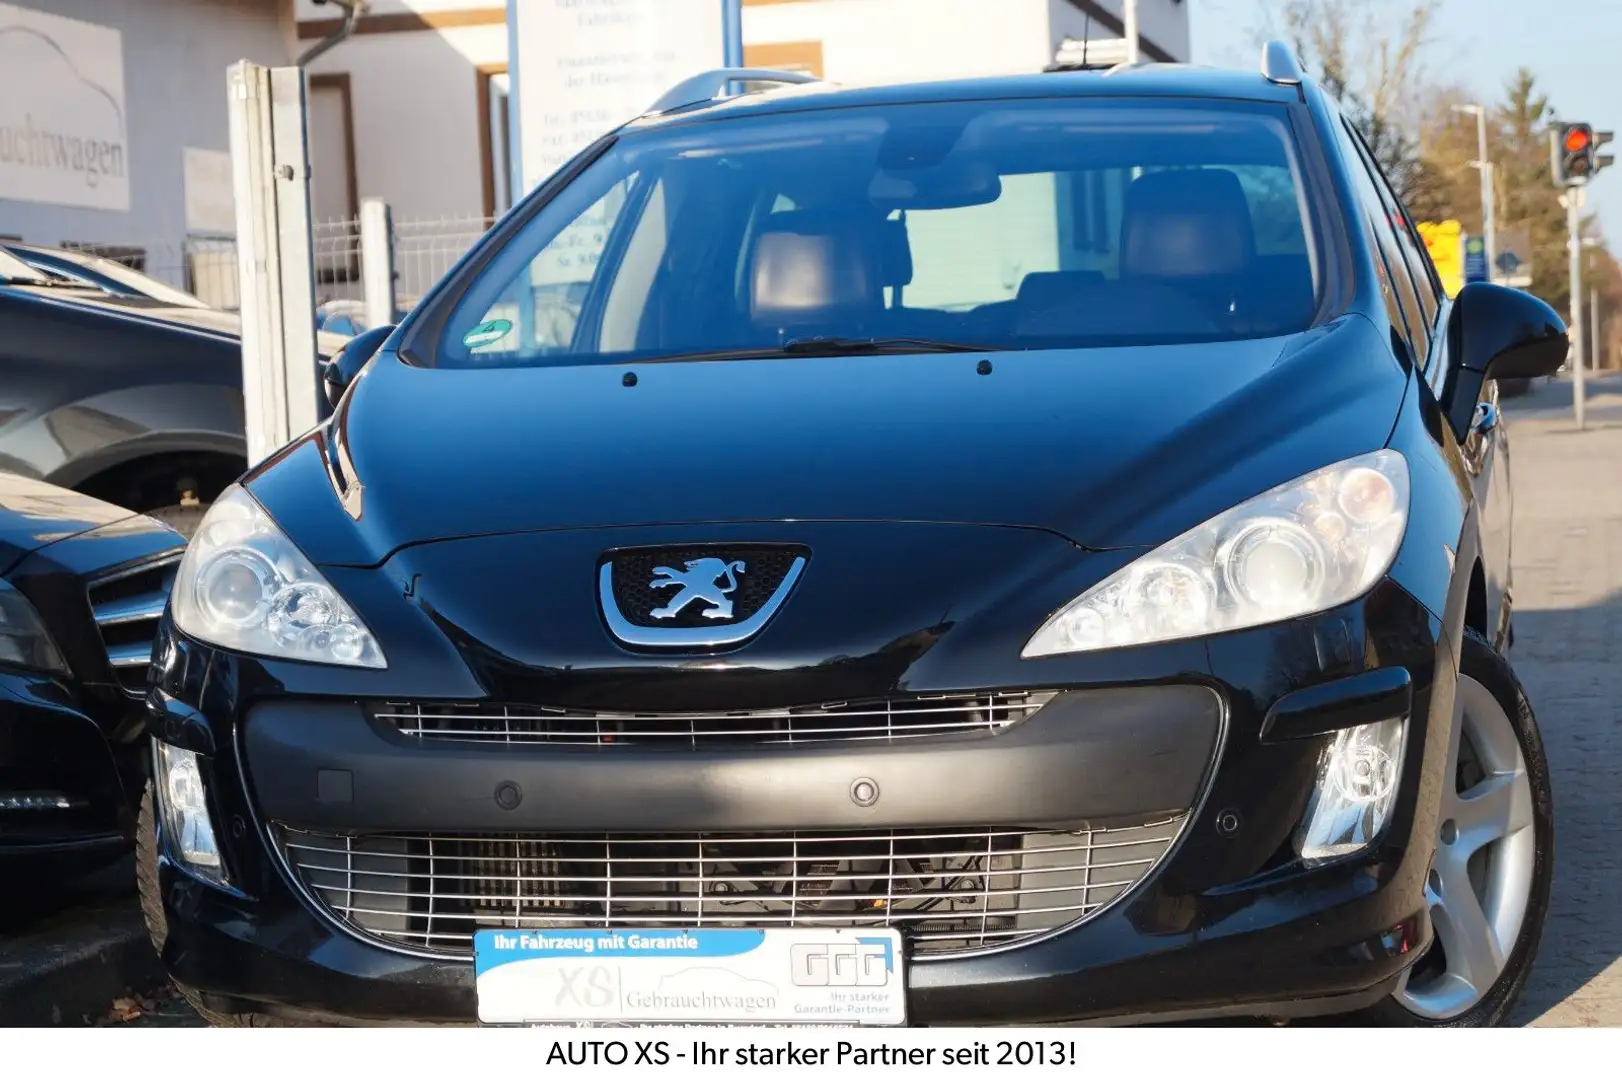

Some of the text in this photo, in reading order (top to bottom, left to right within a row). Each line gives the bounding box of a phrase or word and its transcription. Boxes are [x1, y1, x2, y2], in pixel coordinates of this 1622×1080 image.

[494, 934, 698, 952] Ihr Fahrzeug mit Garantie
[554, 965, 614, 1008] XS
[627, 991, 776, 1013] Gebrauchtwagen
[831, 992, 889, 1002] Ihr starker
[794, 1003, 890, 1015] Garantie-Partner
